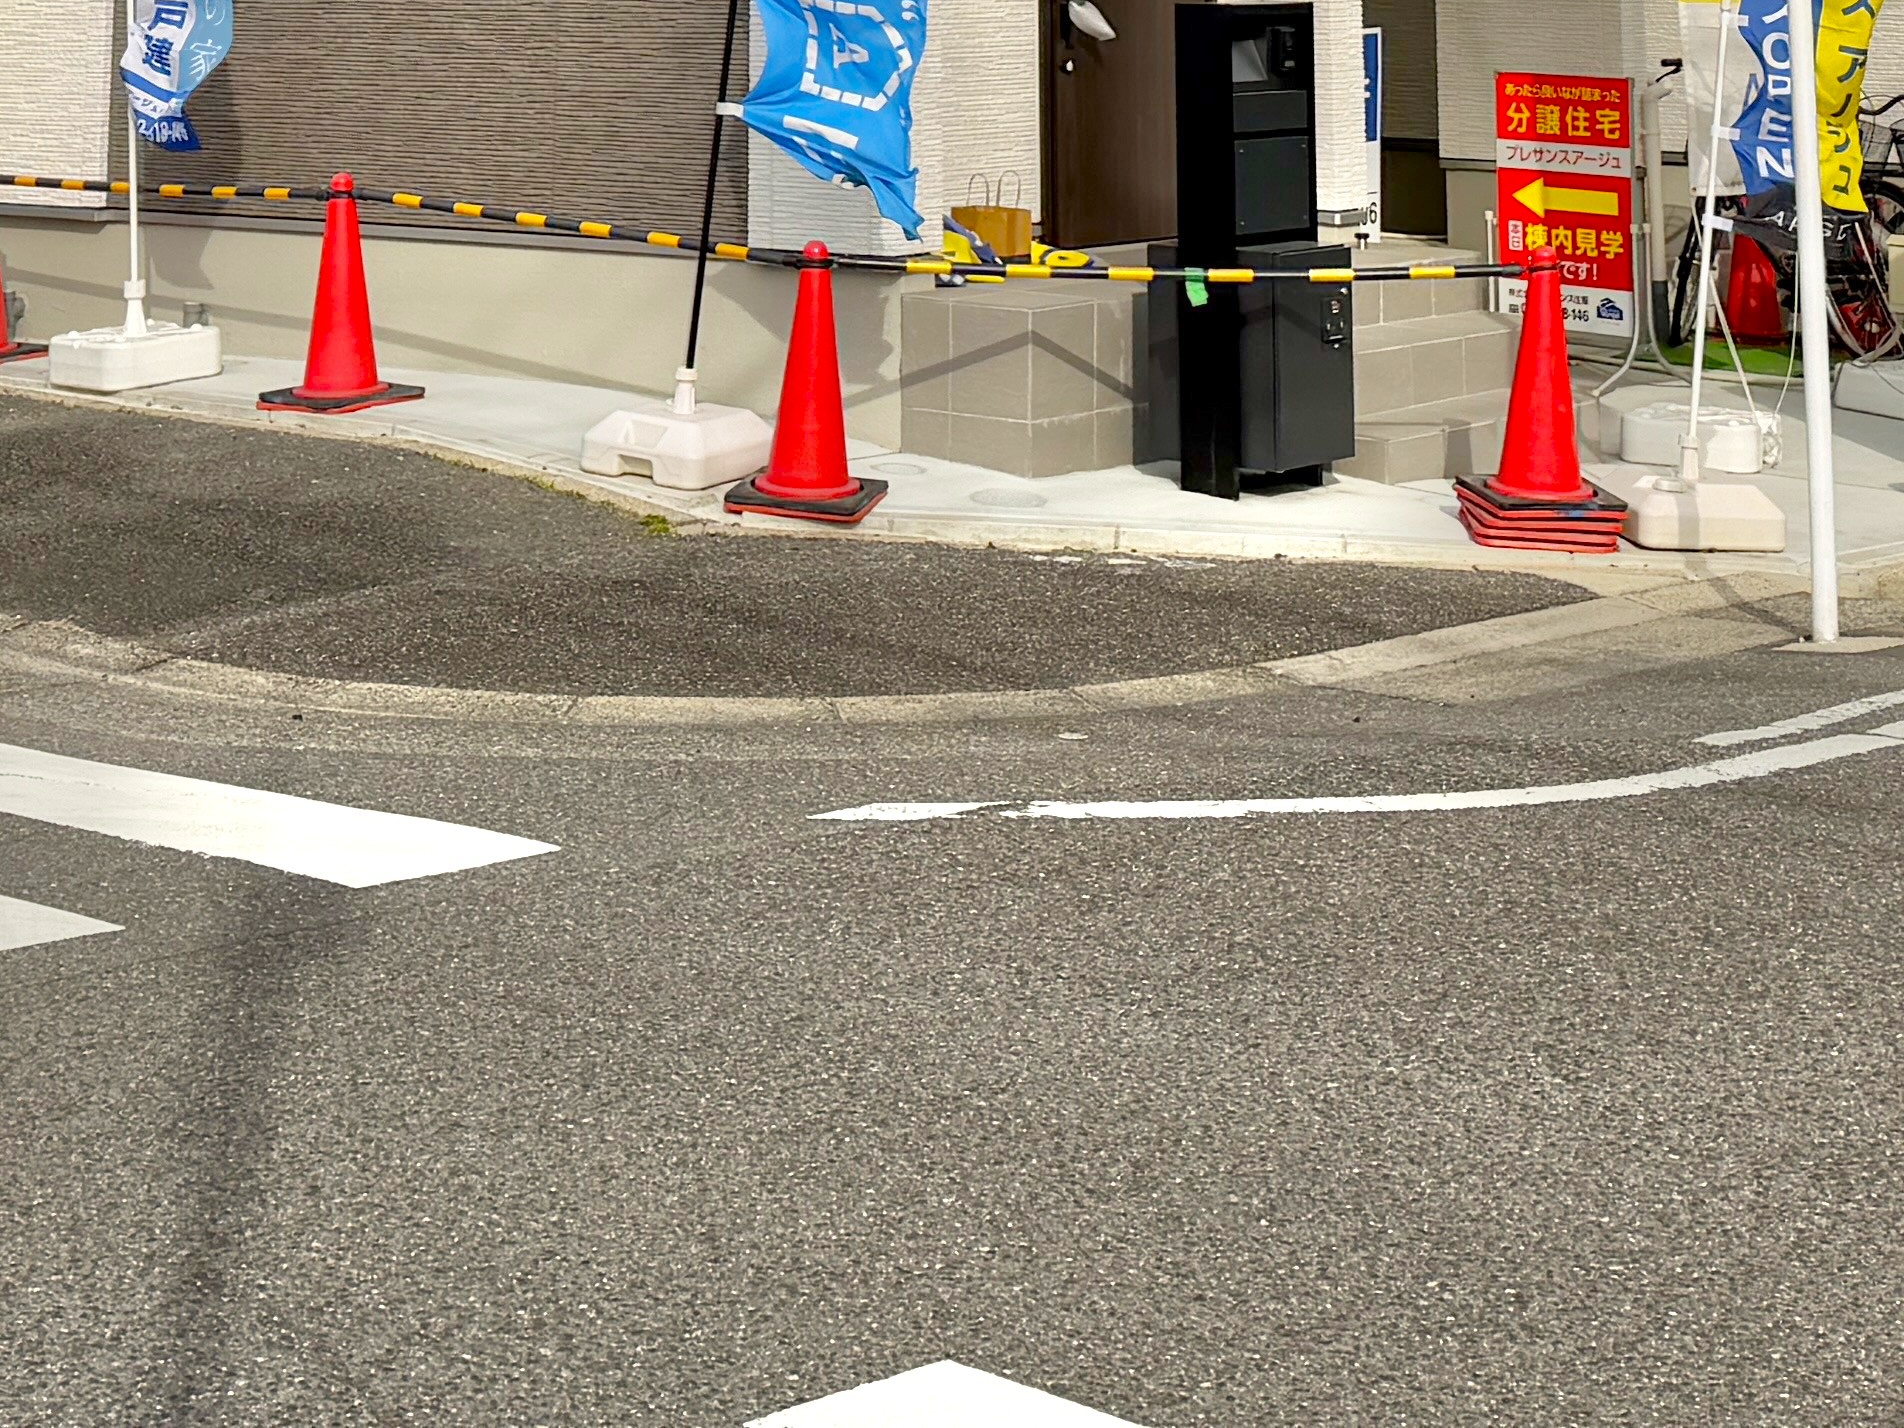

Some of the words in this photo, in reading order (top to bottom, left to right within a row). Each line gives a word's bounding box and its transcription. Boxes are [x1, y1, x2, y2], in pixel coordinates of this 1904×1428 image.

[1506, 102, 1621, 140] 分譲住宅
[1506, 145, 1622, 169] プレサンスアージュ
